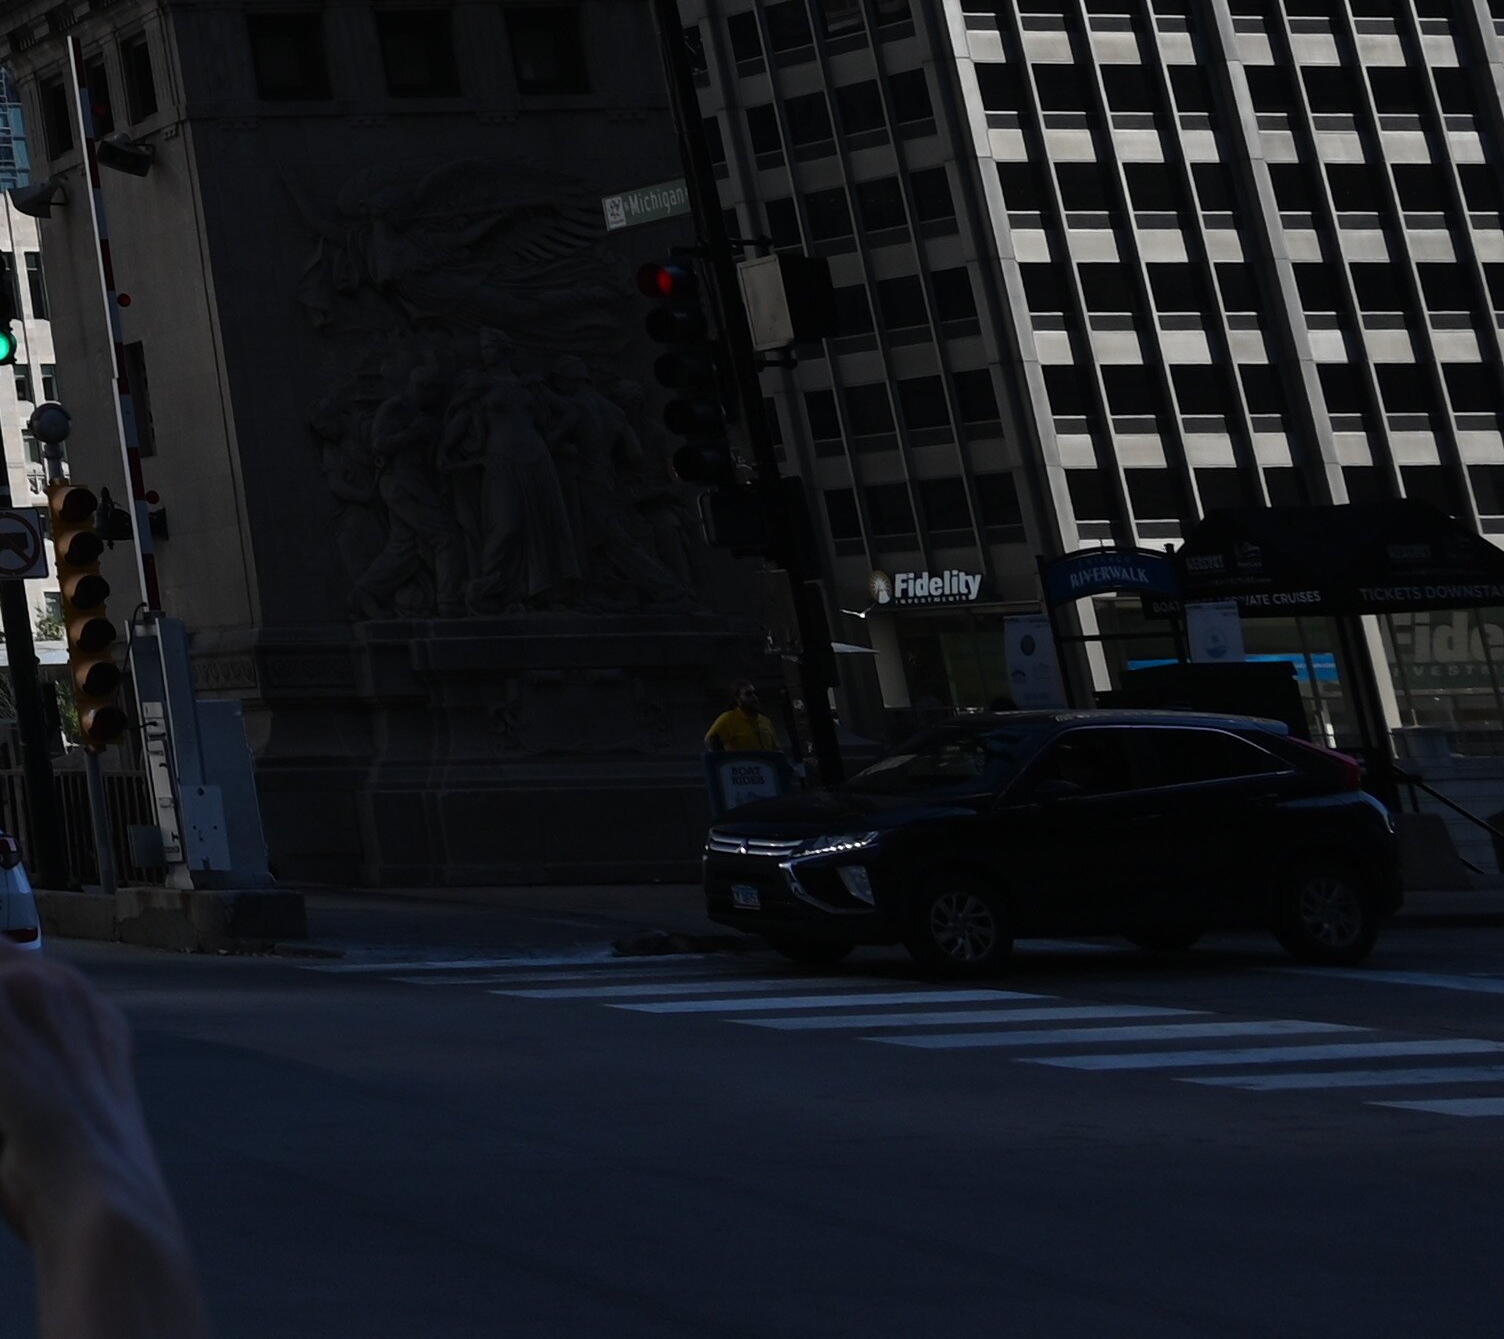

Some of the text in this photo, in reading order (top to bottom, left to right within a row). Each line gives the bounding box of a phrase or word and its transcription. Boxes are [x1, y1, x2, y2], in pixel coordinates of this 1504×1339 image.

[629, 186, 686, 216] Michigan
[894, 569, 983, 601] Fidelity
[1069, 566, 1151, 590] RIVERWALK
[1152, 601, 1180, 614] BOAT
[1272, 590, 1322, 606] CRUISES
[1358, 586, 1422, 601] TICKETS
[732, 766, 761, 776] BOAT
